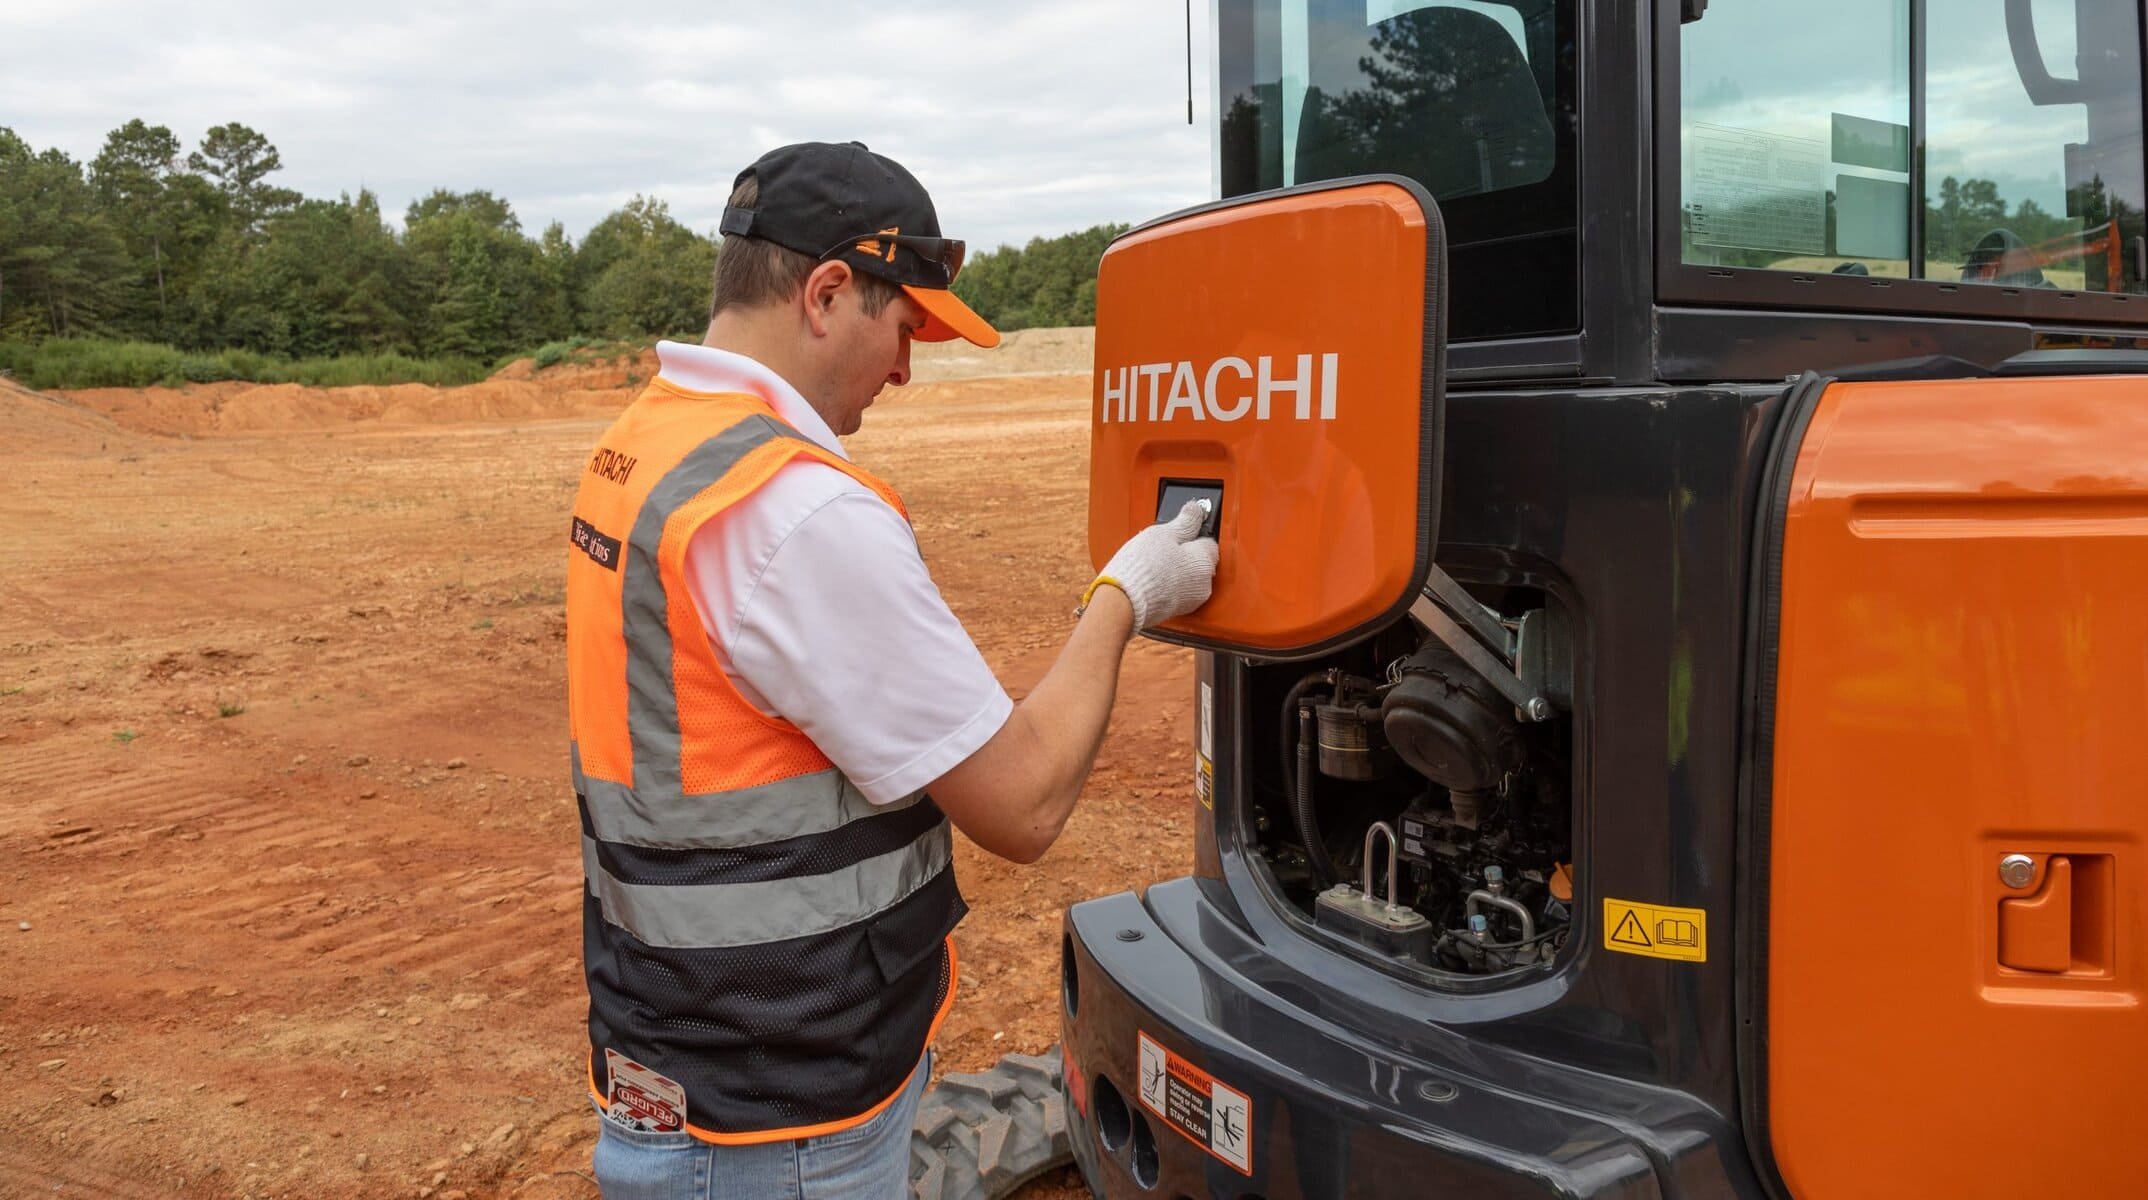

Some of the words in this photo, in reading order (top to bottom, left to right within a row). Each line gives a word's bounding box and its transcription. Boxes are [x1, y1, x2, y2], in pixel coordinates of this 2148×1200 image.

[1103, 353, 1338, 423] HITACHI
[590, 448, 637, 485] HITACHI
[1170, 1079, 1191, 1098] Operator
[1191, 1095, 1203, 1107] may
[1173, 1061, 1212, 1093] WARNING
[621, 1090, 673, 1123] PELIGRO
[1191, 1103, 1210, 1120] reverse
[1170, 1107, 1184, 1123] STAY
[1185, 1118, 1206, 1139] CLEAR
